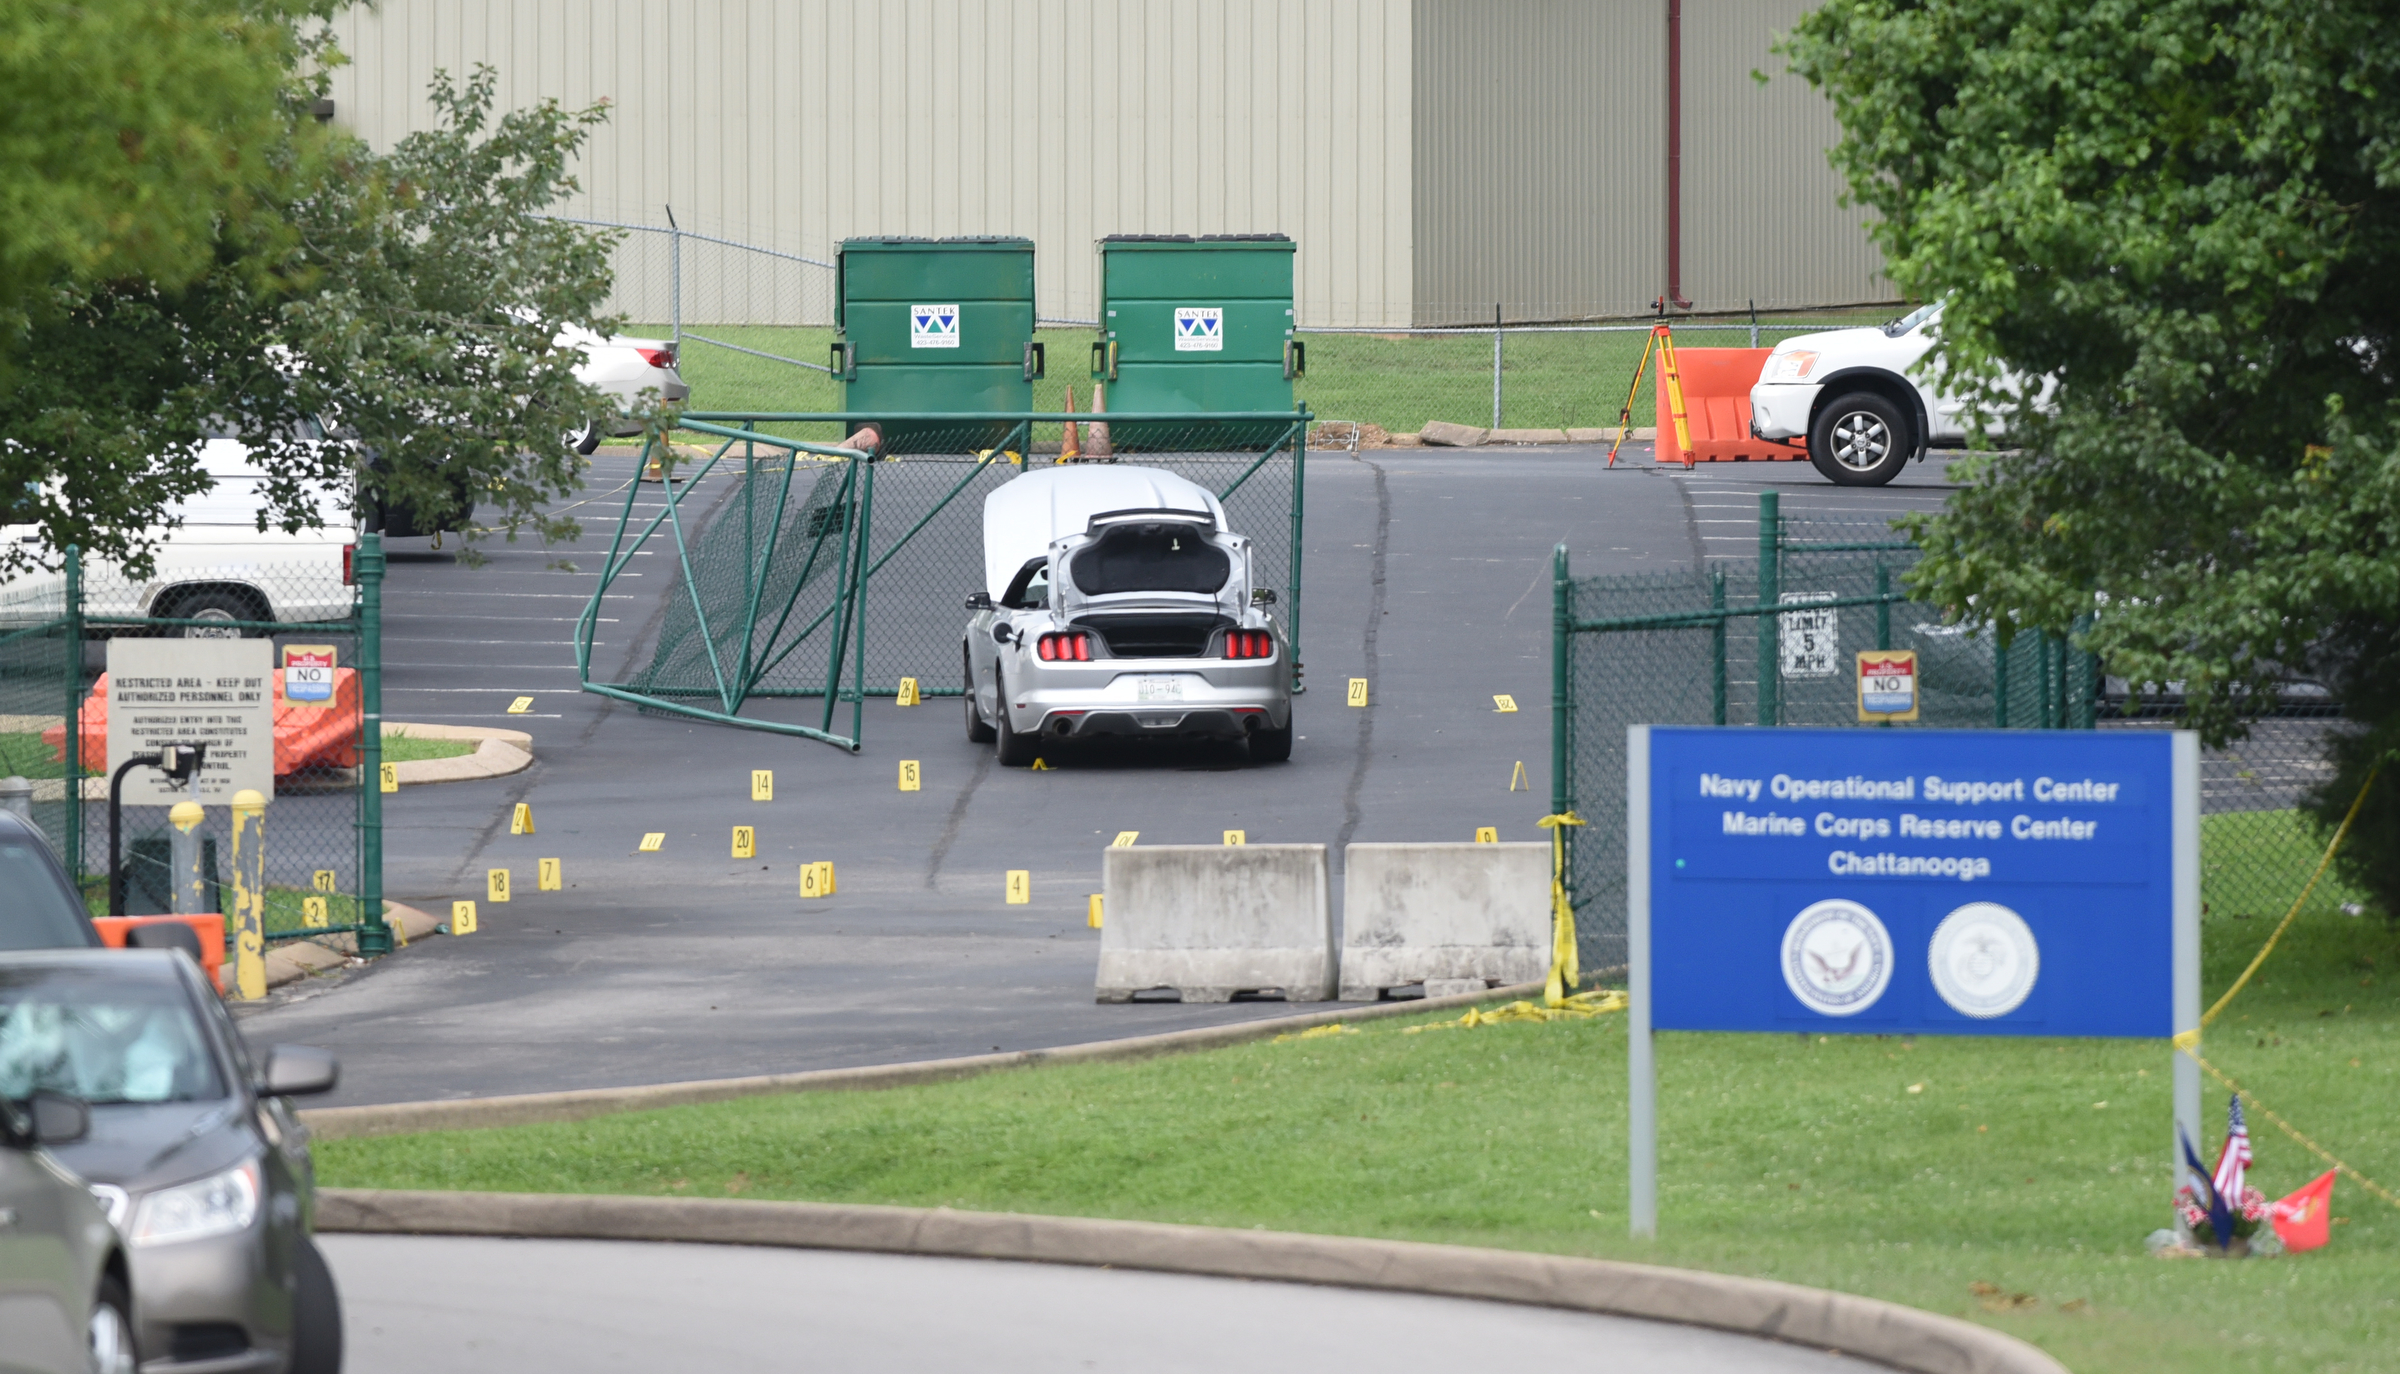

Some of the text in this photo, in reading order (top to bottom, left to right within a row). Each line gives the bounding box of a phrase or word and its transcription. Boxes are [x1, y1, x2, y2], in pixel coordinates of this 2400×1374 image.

[914, 307, 955, 315] SANTEK
[1177, 310, 1218, 318] SANTEK
[1789, 616, 1826, 630] LIMIT
[1804, 633, 1814, 652] 5
[1795, 655, 1825, 669] MPH
[116, 678, 172, 688] RESTRICTED
[177, 678, 201, 688] AREA
[216, 678, 240, 688] KEEP
[244, 678, 262, 688] OUT
[297, 668, 321, 681] NO
[1873, 676, 1900, 691] NO
[117, 691, 261, 702] AUTHORIZED PERSONNEL ONLY
[900, 680, 910, 699] 26
[1351, 681, 1364, 700] 27
[380, 765, 394, 783] 16
[904, 763, 915, 782] 15
[757, 774, 769, 793] 14
[1700, 773, 2120, 805] Navy Operational Support Center
[1723, 811, 2098, 841] Marine Corps Reserve Center
[737, 829, 749, 849] 20
[545, 861, 552, 882] 7
[1828, 850, 1991, 882] Chattanooga
[492, 872, 504, 892] 18
[806, 868, 814, 889] 6
[1012, 875, 1020, 894] 4
[310, 902, 319, 923] 2
[460, 906, 469, 927] 3
